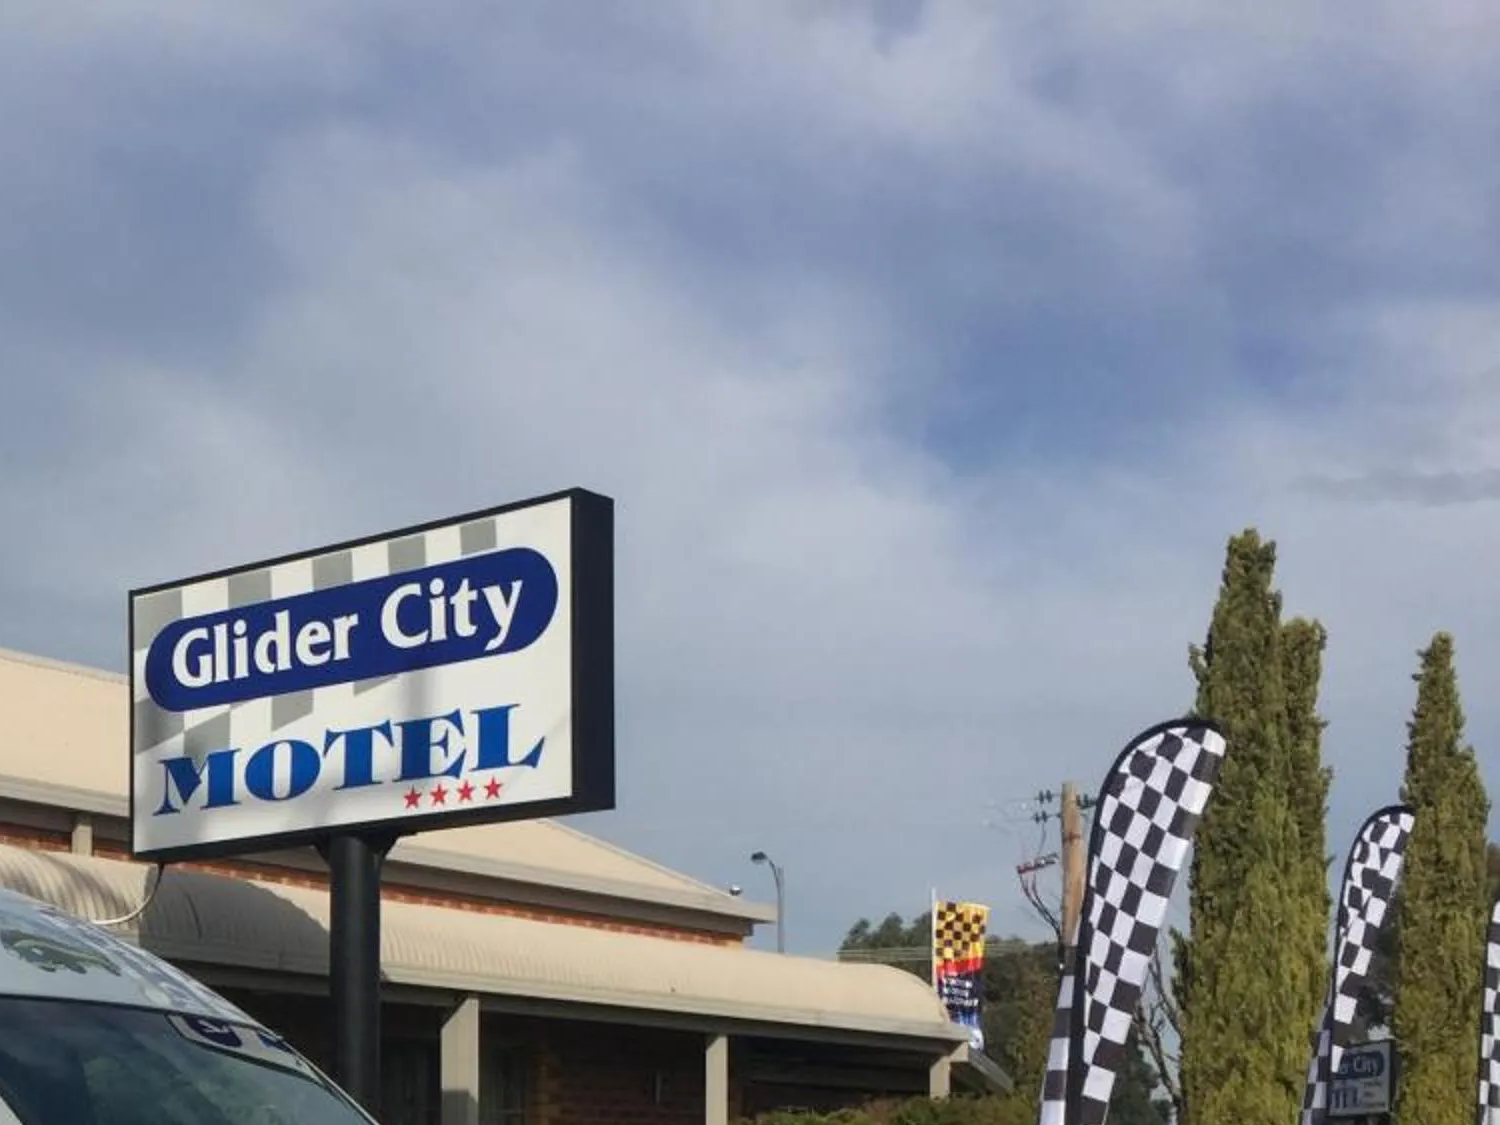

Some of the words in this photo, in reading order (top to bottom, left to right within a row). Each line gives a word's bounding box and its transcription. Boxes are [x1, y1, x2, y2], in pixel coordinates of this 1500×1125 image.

[172, 610, 358, 689] Glider
[380, 576, 523, 651] City
[152, 703, 546, 817] MOTEL
